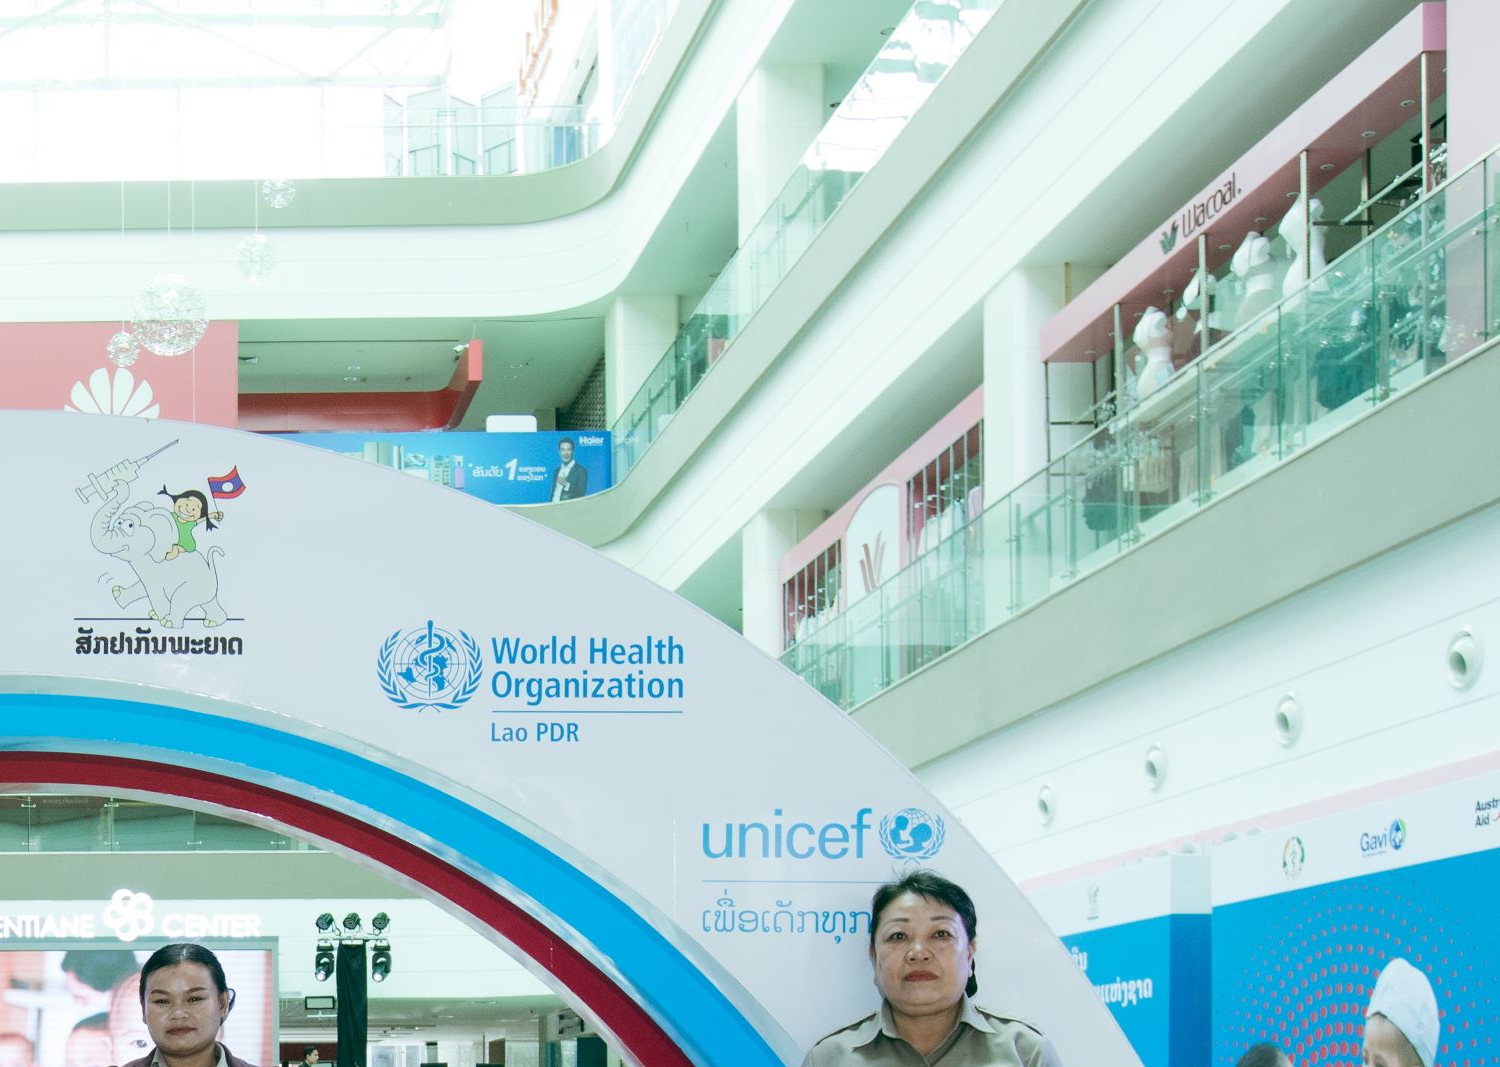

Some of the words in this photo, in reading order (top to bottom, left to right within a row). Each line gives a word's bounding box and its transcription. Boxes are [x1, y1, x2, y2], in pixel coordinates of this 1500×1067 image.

[491, 635, 577, 665] World
[589, 635, 684, 665] Health
[491, 670, 684, 706] Organization
[491, 722, 528, 742] Lao
[536, 722, 579, 742] PDR
[1475, 814, 1490, 827] Aid
[702, 807, 873, 860] unicef
[1360, 828, 1388, 853] Gavi
[162, 913, 261, 938] CENTER
